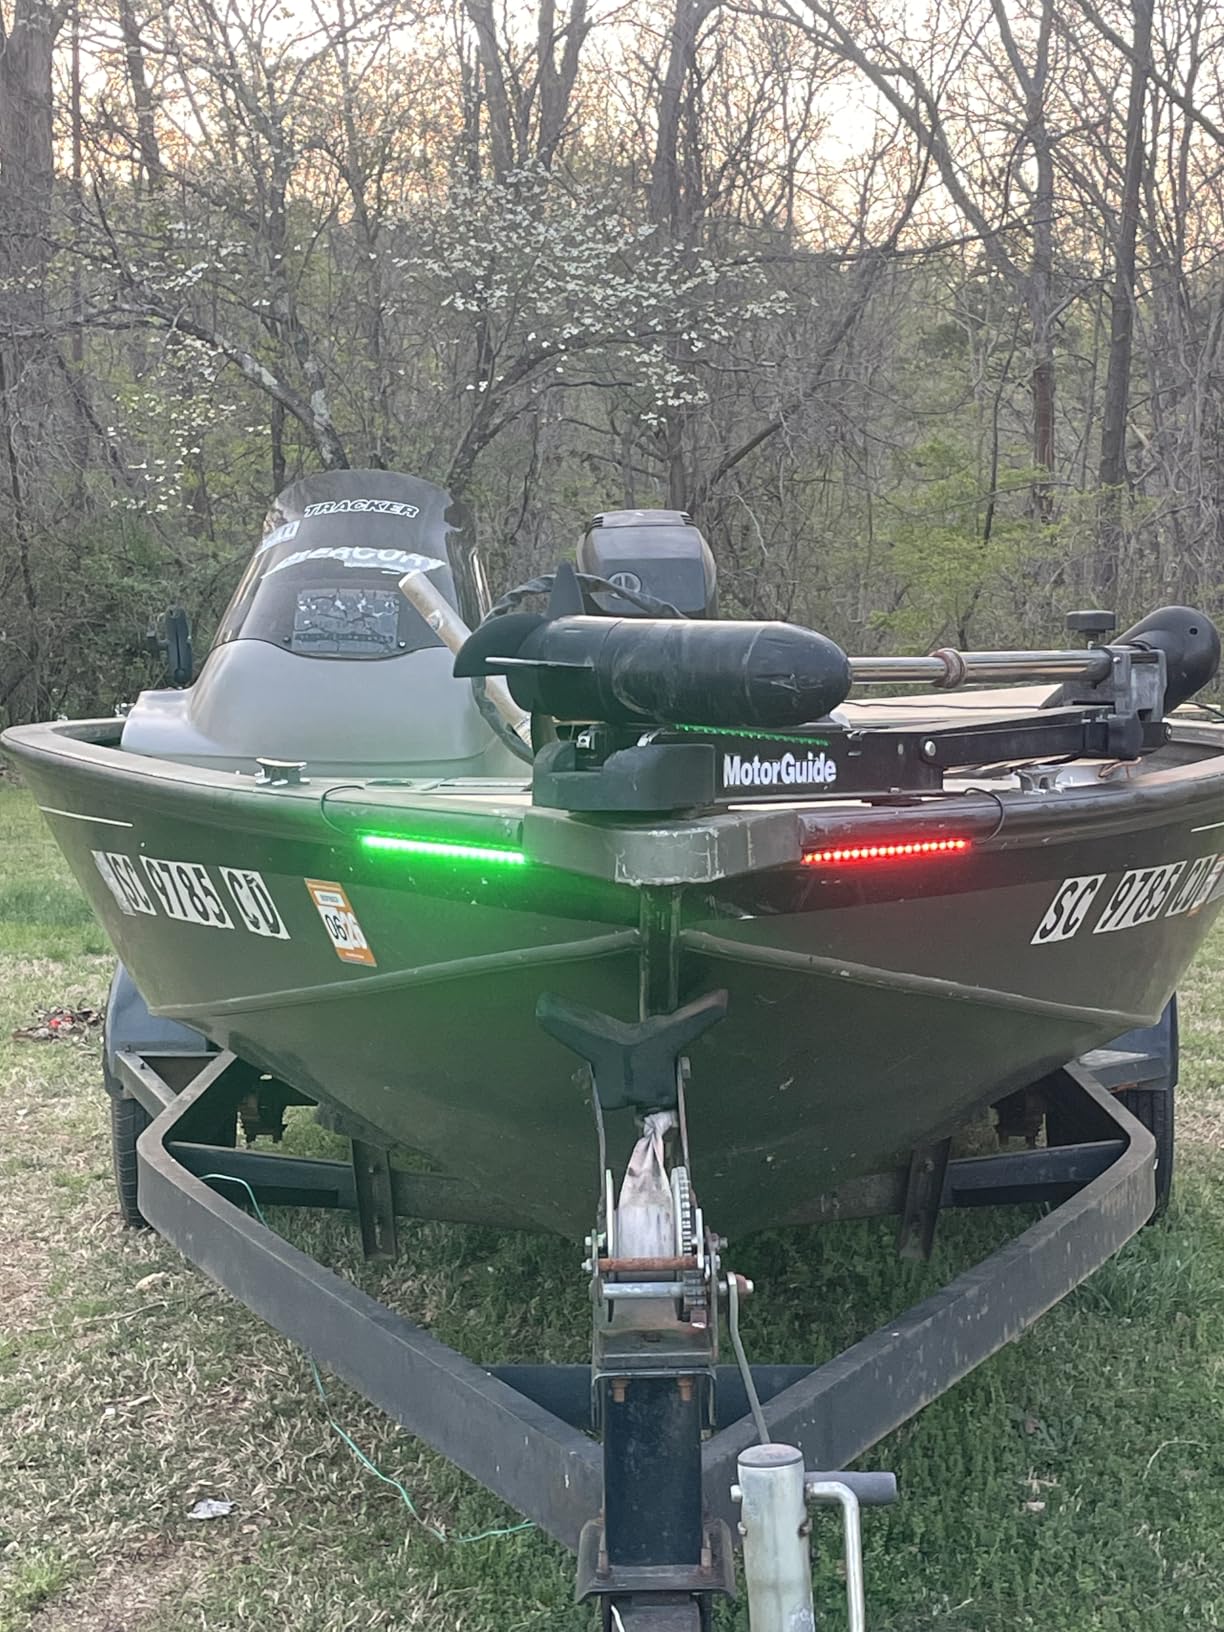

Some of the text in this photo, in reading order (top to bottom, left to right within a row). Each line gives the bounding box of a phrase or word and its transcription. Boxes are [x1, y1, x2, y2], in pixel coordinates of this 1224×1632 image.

[303, 499, 420, 519] TRACKER
[723, 751, 837, 788] MotorGuide
[110, 854, 282, 935] SC 9785 CD
[1037, 876, 1099, 940] SC
[1099, 862, 1185, 930] 9785
[324, 913, 348, 941] 06
